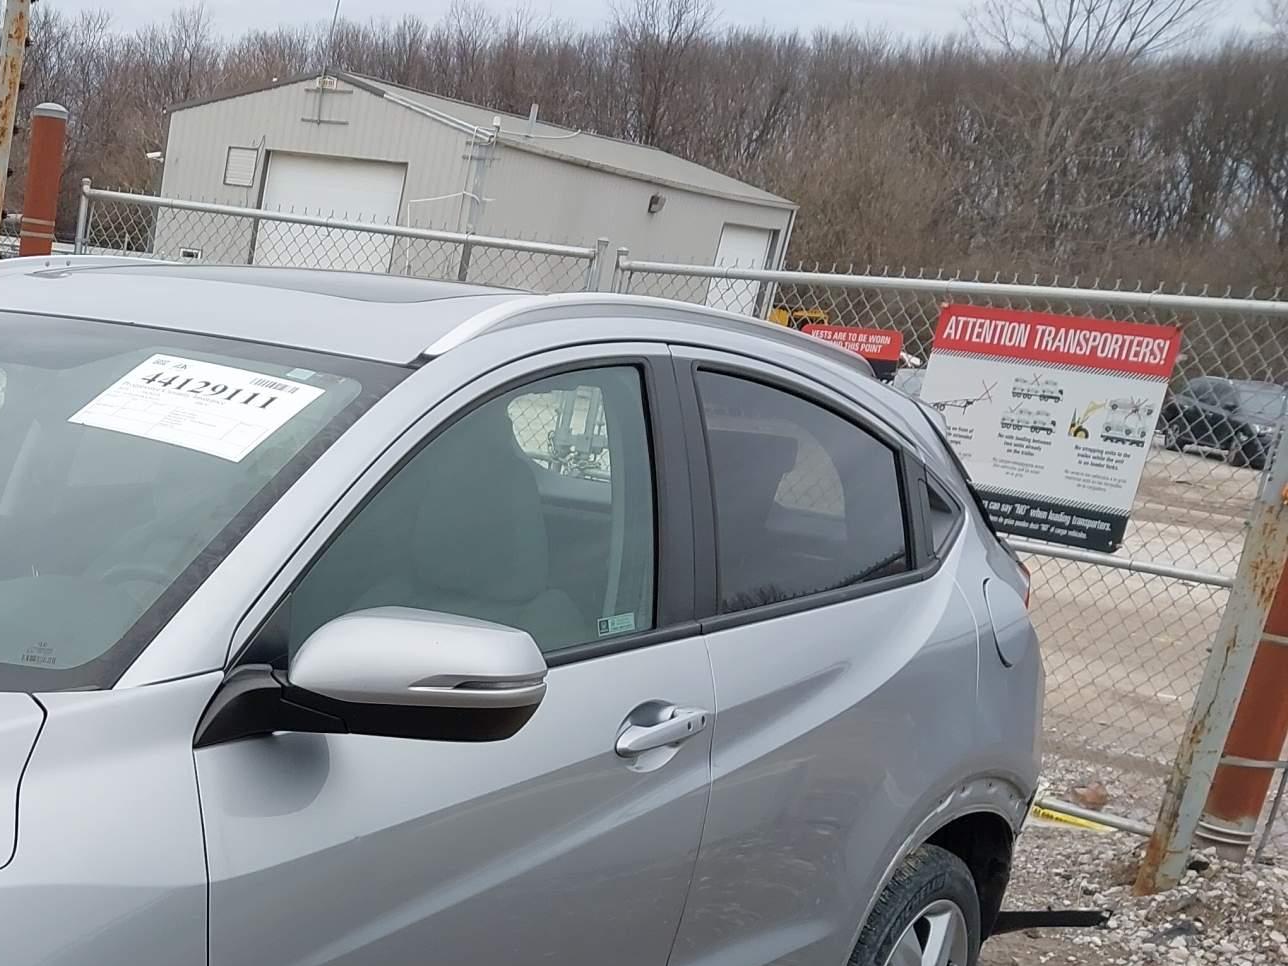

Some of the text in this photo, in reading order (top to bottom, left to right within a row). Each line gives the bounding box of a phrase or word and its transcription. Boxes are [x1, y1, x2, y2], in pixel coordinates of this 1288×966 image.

[812, 329, 891, 345] VESTS ARE TO BE WORN
[844, 341, 860, 352] THIS
[860, 343, 882, 353] POINT
[943, 316, 1170, 365] ATTENTION TRANSPORTERS!
[141, 372, 278, 409] 44129111
[989, 500, 1000, 510] can
[1001, 502, 1013, 514] say
[1030, 508, 1048, 519] when
[1048, 510, 1071, 526] loading
